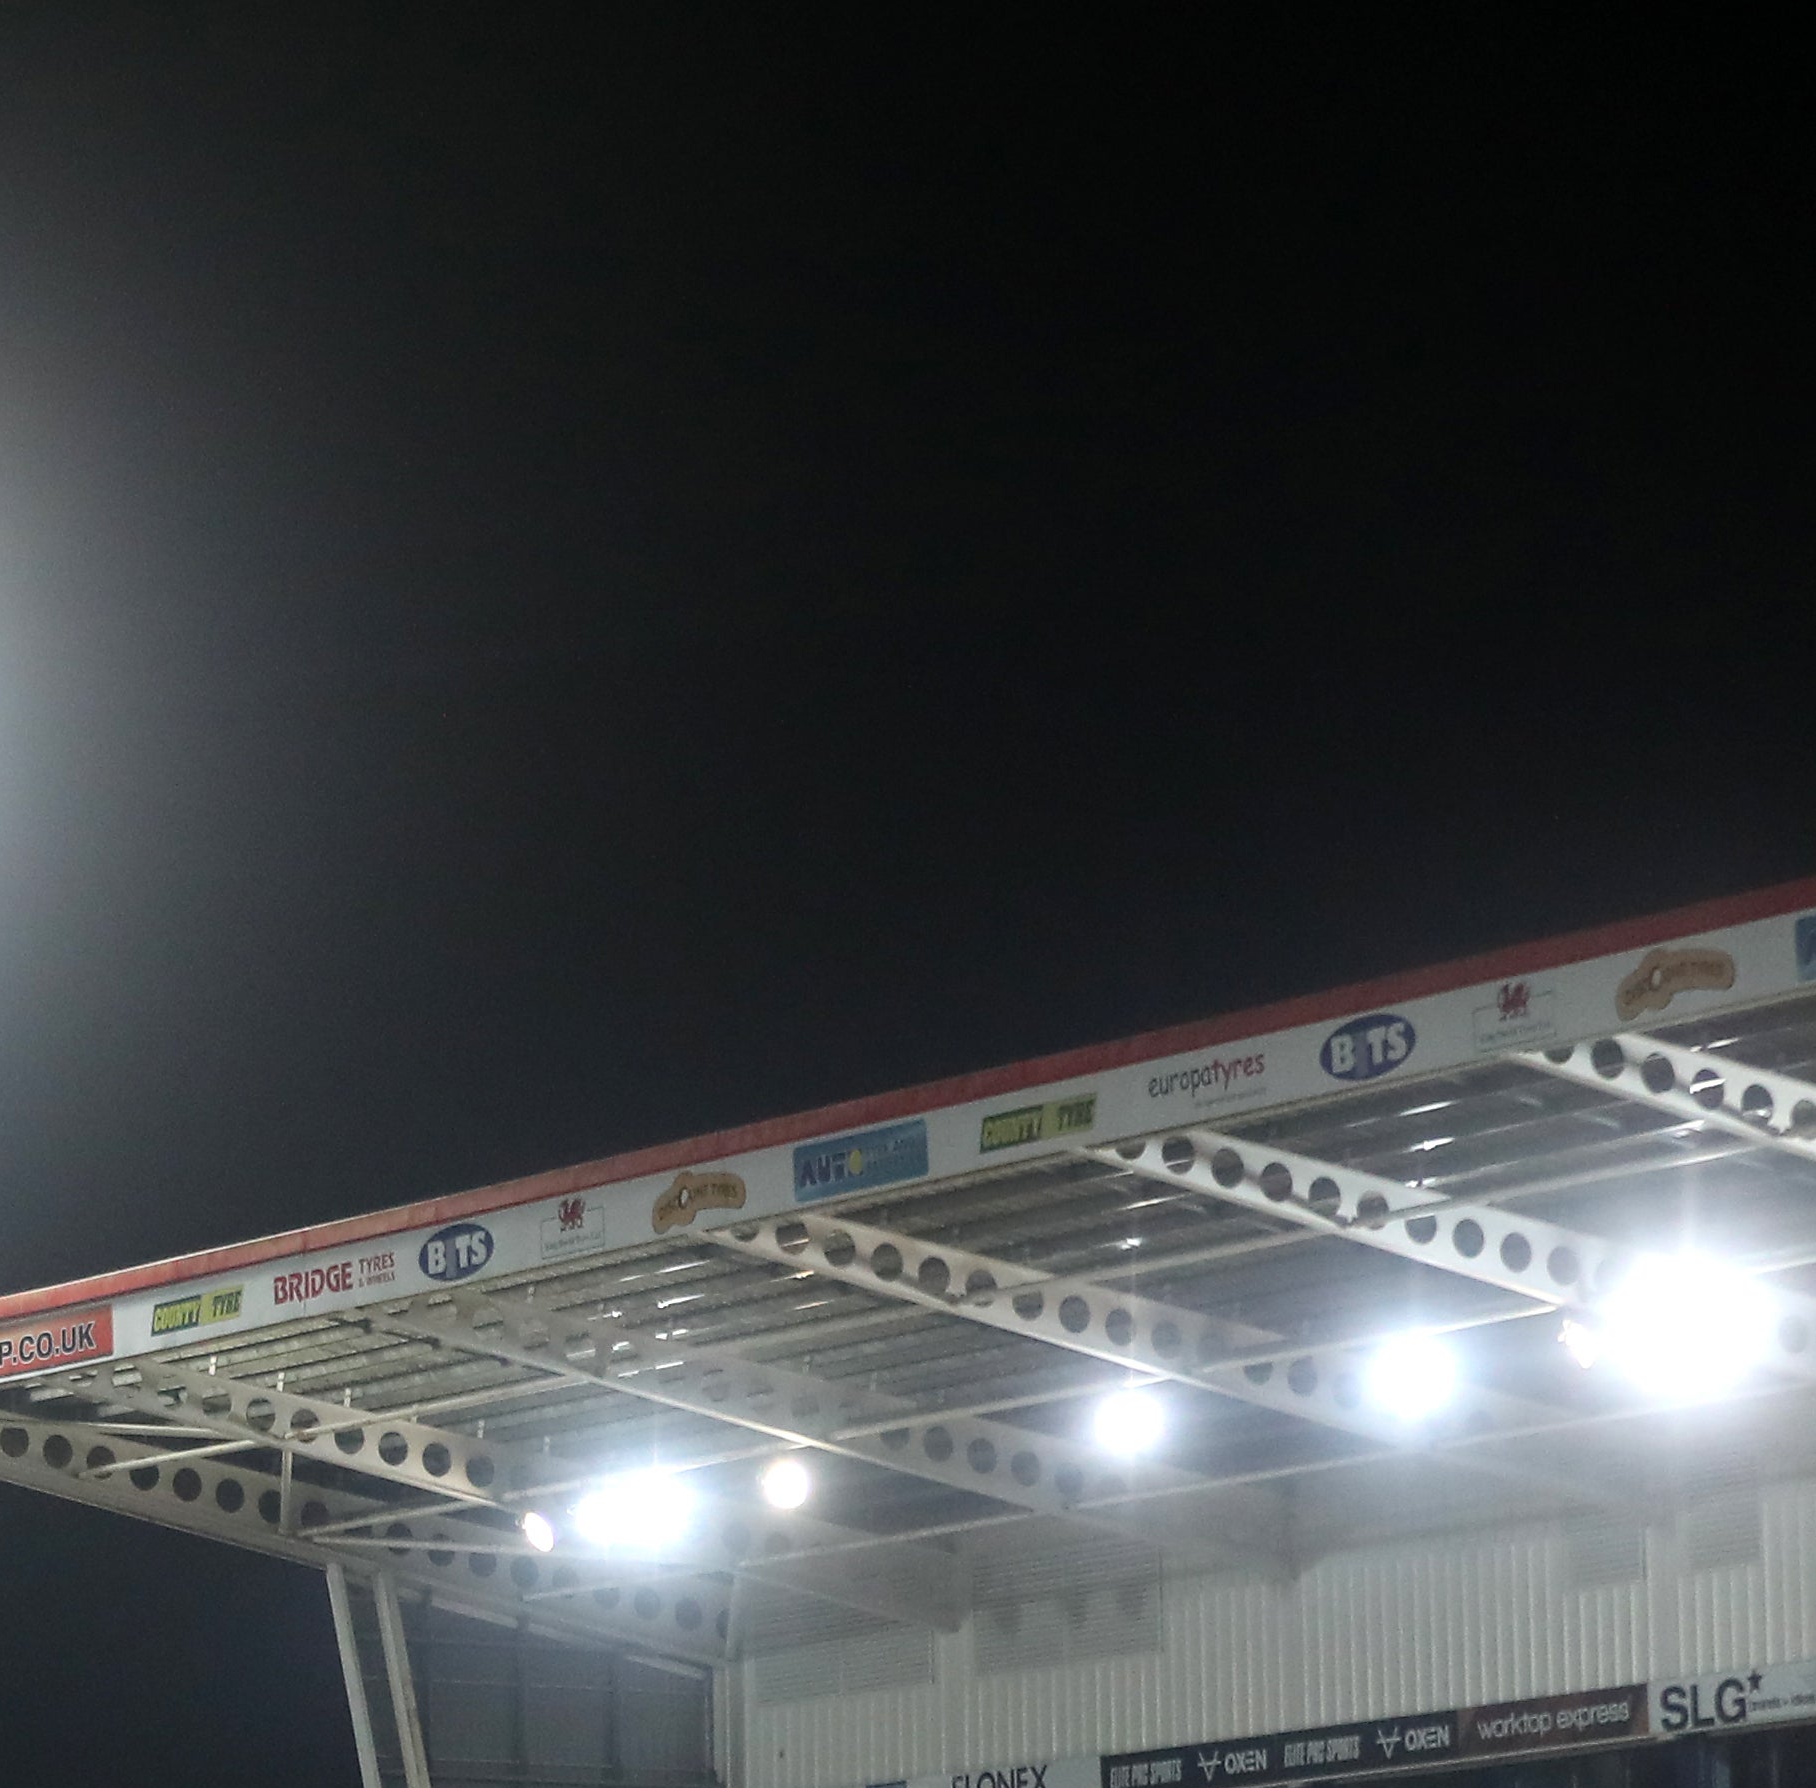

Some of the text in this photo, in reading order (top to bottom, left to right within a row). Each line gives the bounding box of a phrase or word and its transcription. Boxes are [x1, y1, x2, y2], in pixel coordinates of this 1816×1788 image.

[1148, 1053, 1265, 1097] europatyres
[273, 1252, 396, 1305] BRIDGE TYRES
[1477, 1700, 1630, 1740] worktop express
[1660, 1677, 1748, 1731] SLG
[1404, 1725, 1450, 1751] OXEN
[1224, 1750, 1267, 1775] OXEN
